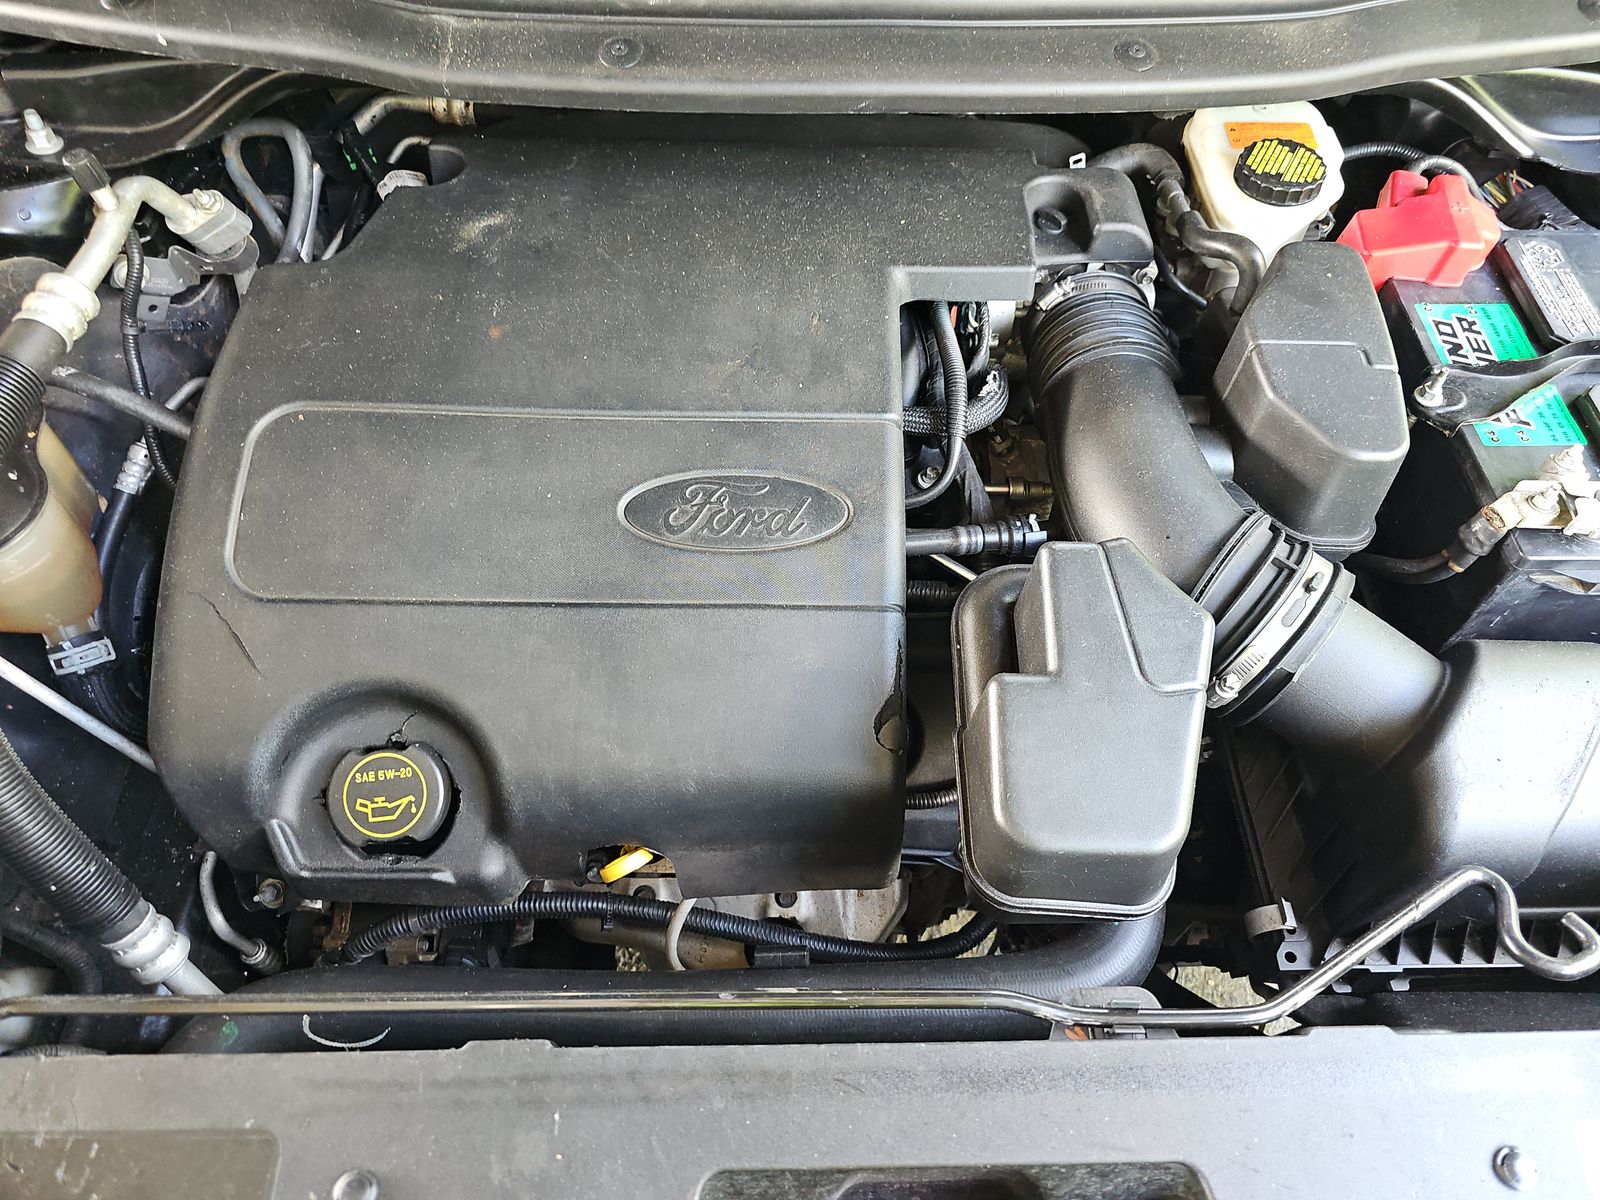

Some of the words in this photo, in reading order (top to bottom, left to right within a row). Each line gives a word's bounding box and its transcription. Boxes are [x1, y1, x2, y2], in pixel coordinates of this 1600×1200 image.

[663, 480, 812, 537] Ford
[355, 770, 376, 783] SAE
[378, 767, 413, 780] 5W-20
